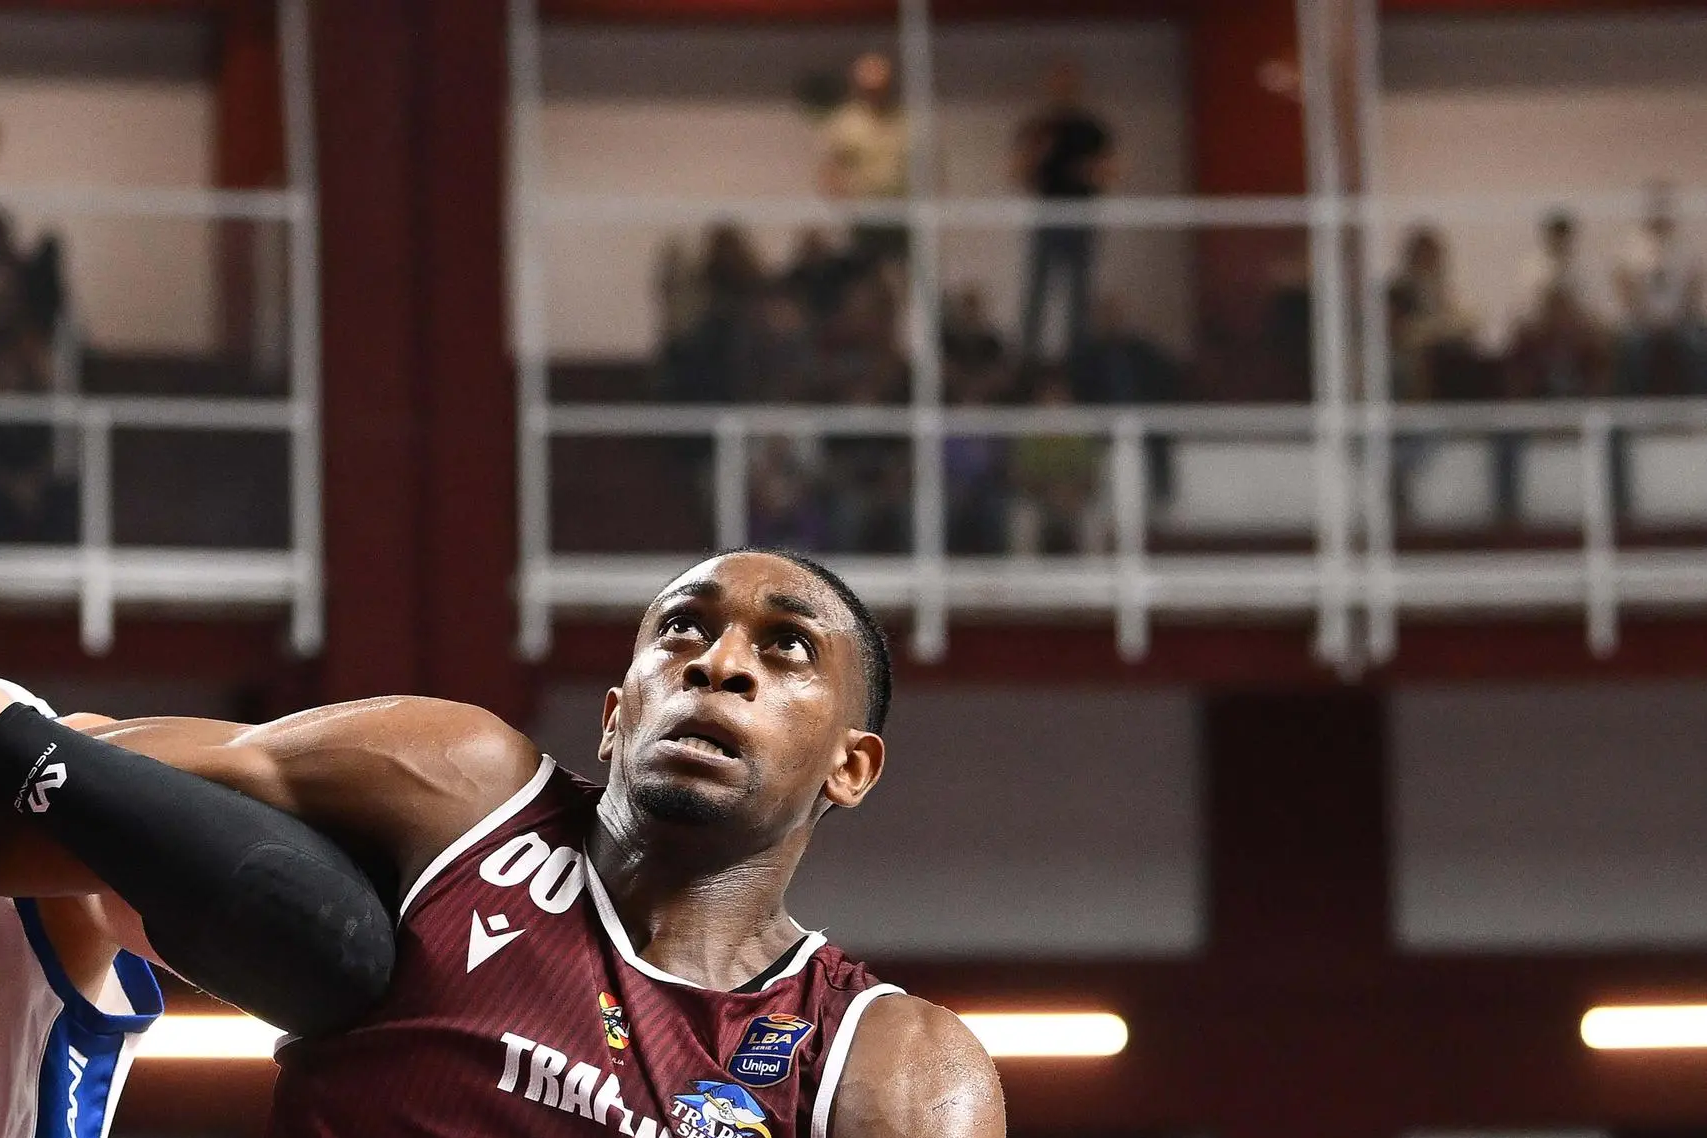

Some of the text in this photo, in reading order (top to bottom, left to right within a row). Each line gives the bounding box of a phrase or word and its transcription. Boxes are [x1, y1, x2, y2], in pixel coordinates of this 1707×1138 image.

[479, 831, 585, 914] 00
[748, 1033, 792, 1044] LBA
[742, 1058, 781, 1076] Unipol
